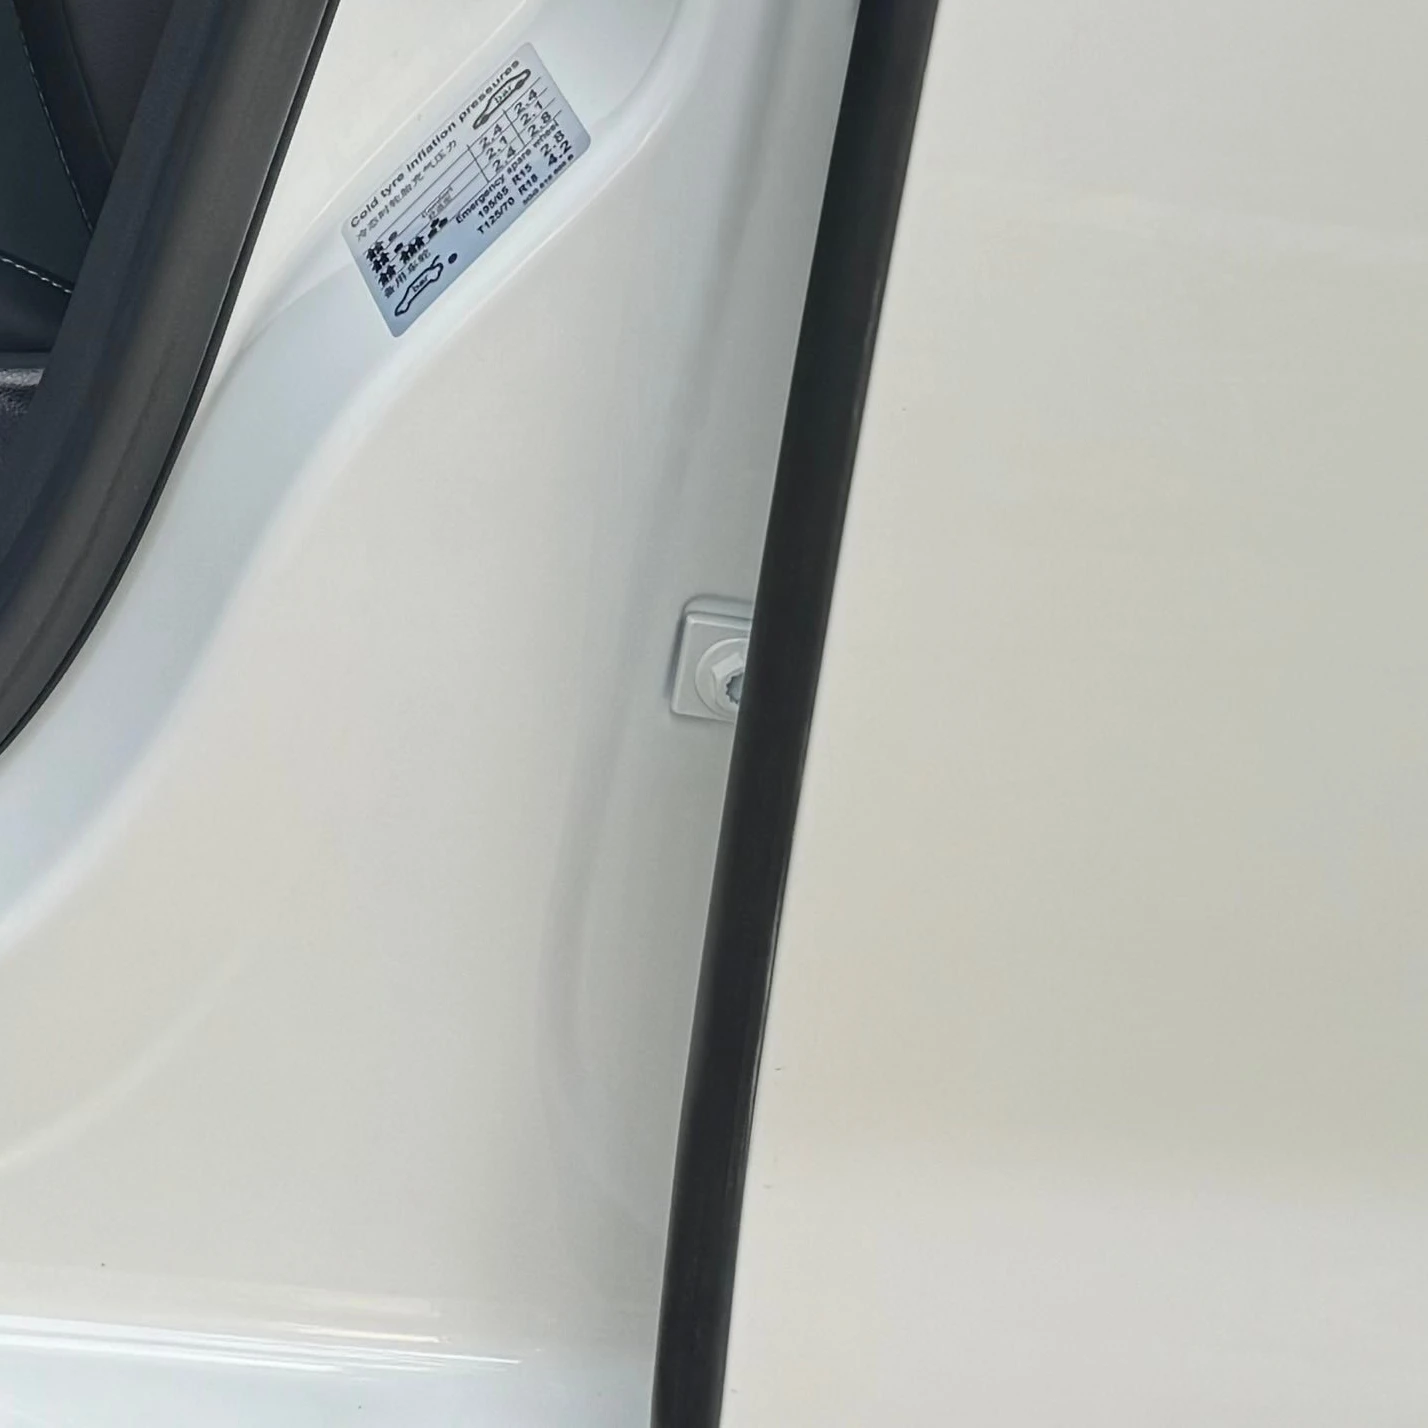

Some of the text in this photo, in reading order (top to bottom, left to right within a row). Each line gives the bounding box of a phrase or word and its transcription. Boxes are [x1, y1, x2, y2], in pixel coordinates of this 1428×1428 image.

[350, 196, 379, 228] Cold
[380, 172, 405, 198] tyre
[458, 60, 520, 124] pressures
[479, 89, 538, 151] 2.4 2.4
[486, 100, 543, 161] 2.1 2.1
[492, 111, 552, 173] 2.4 2.8
[455, 173, 505, 224] Emergency
[507, 148, 532, 175] spare
[476, 196, 515, 235] T125/70
[548, 139, 573, 166] 4.2
[511, 163, 533, 186] R15
[540, 130, 565, 157] 2.8
